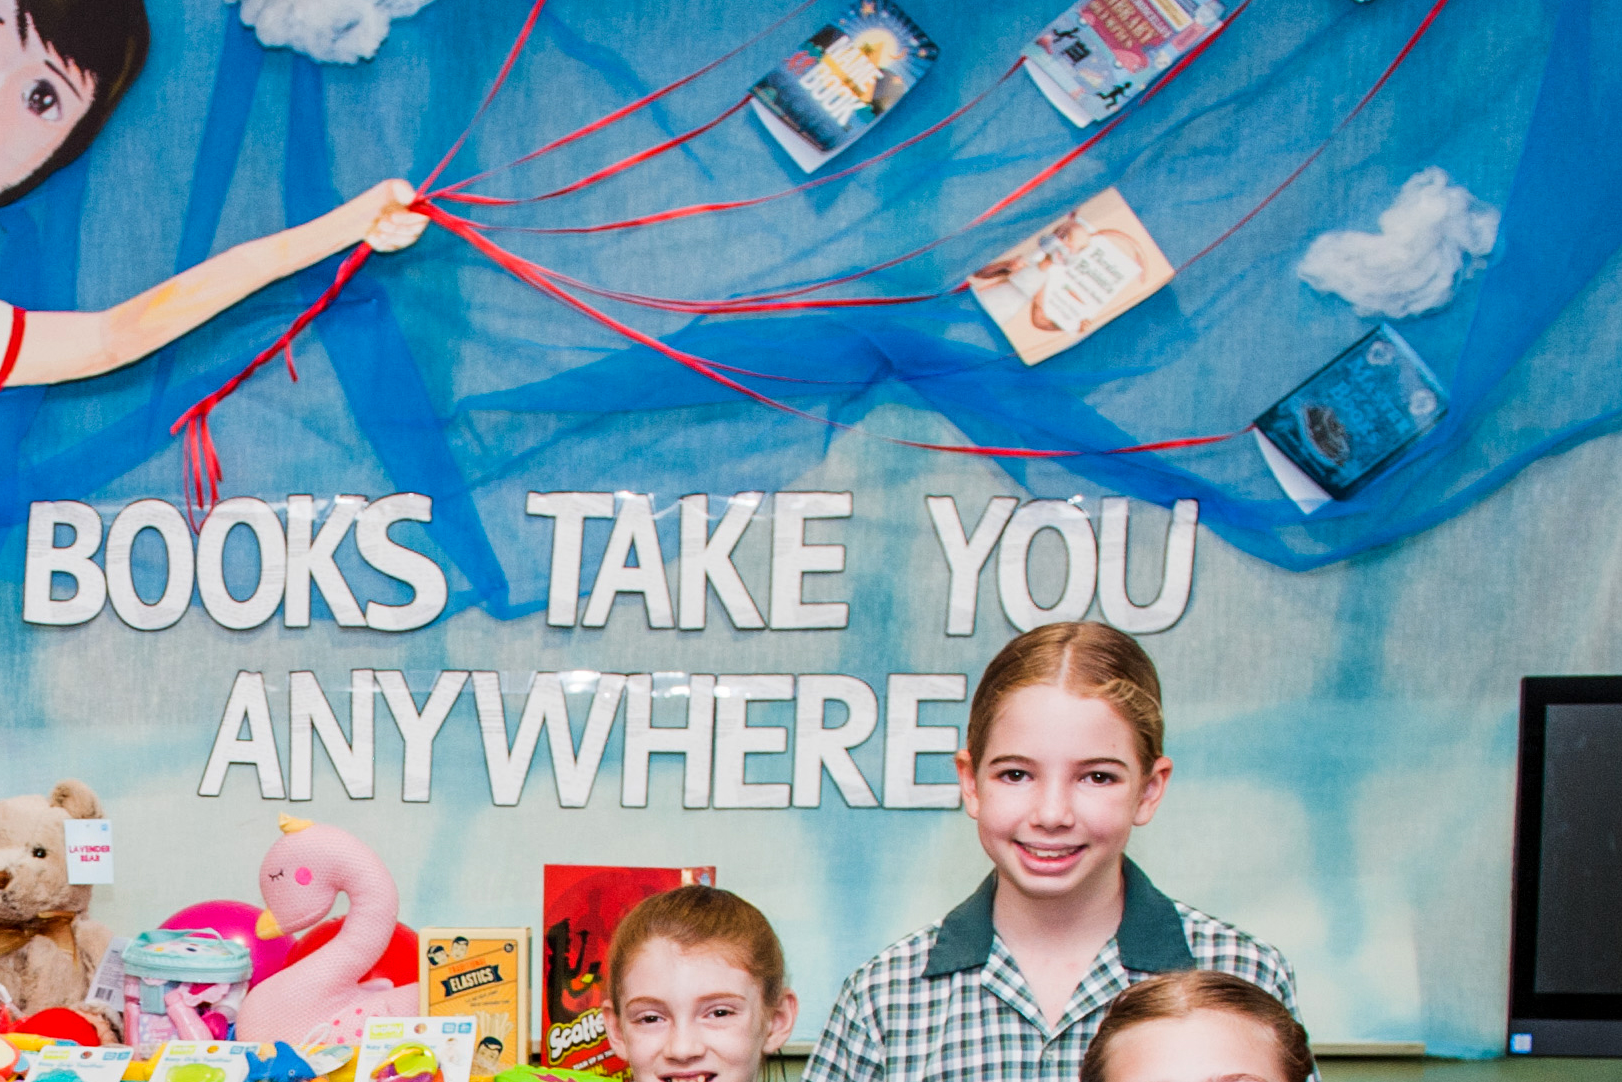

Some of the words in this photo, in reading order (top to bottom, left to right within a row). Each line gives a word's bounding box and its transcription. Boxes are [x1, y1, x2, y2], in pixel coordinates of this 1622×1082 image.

[799, 62, 869, 126] BOOK
[23, 492, 448, 632] BOOKS
[526, 491, 853, 630] TAKE
[926, 493, 1200, 637] YOU
[197, 668, 968, 810] ANYWHERE
[68, 845, 110, 853] LAVENDER
[449, 967, 494, 992] ELASTICS
[550, 1012, 605, 1059] Scatte
